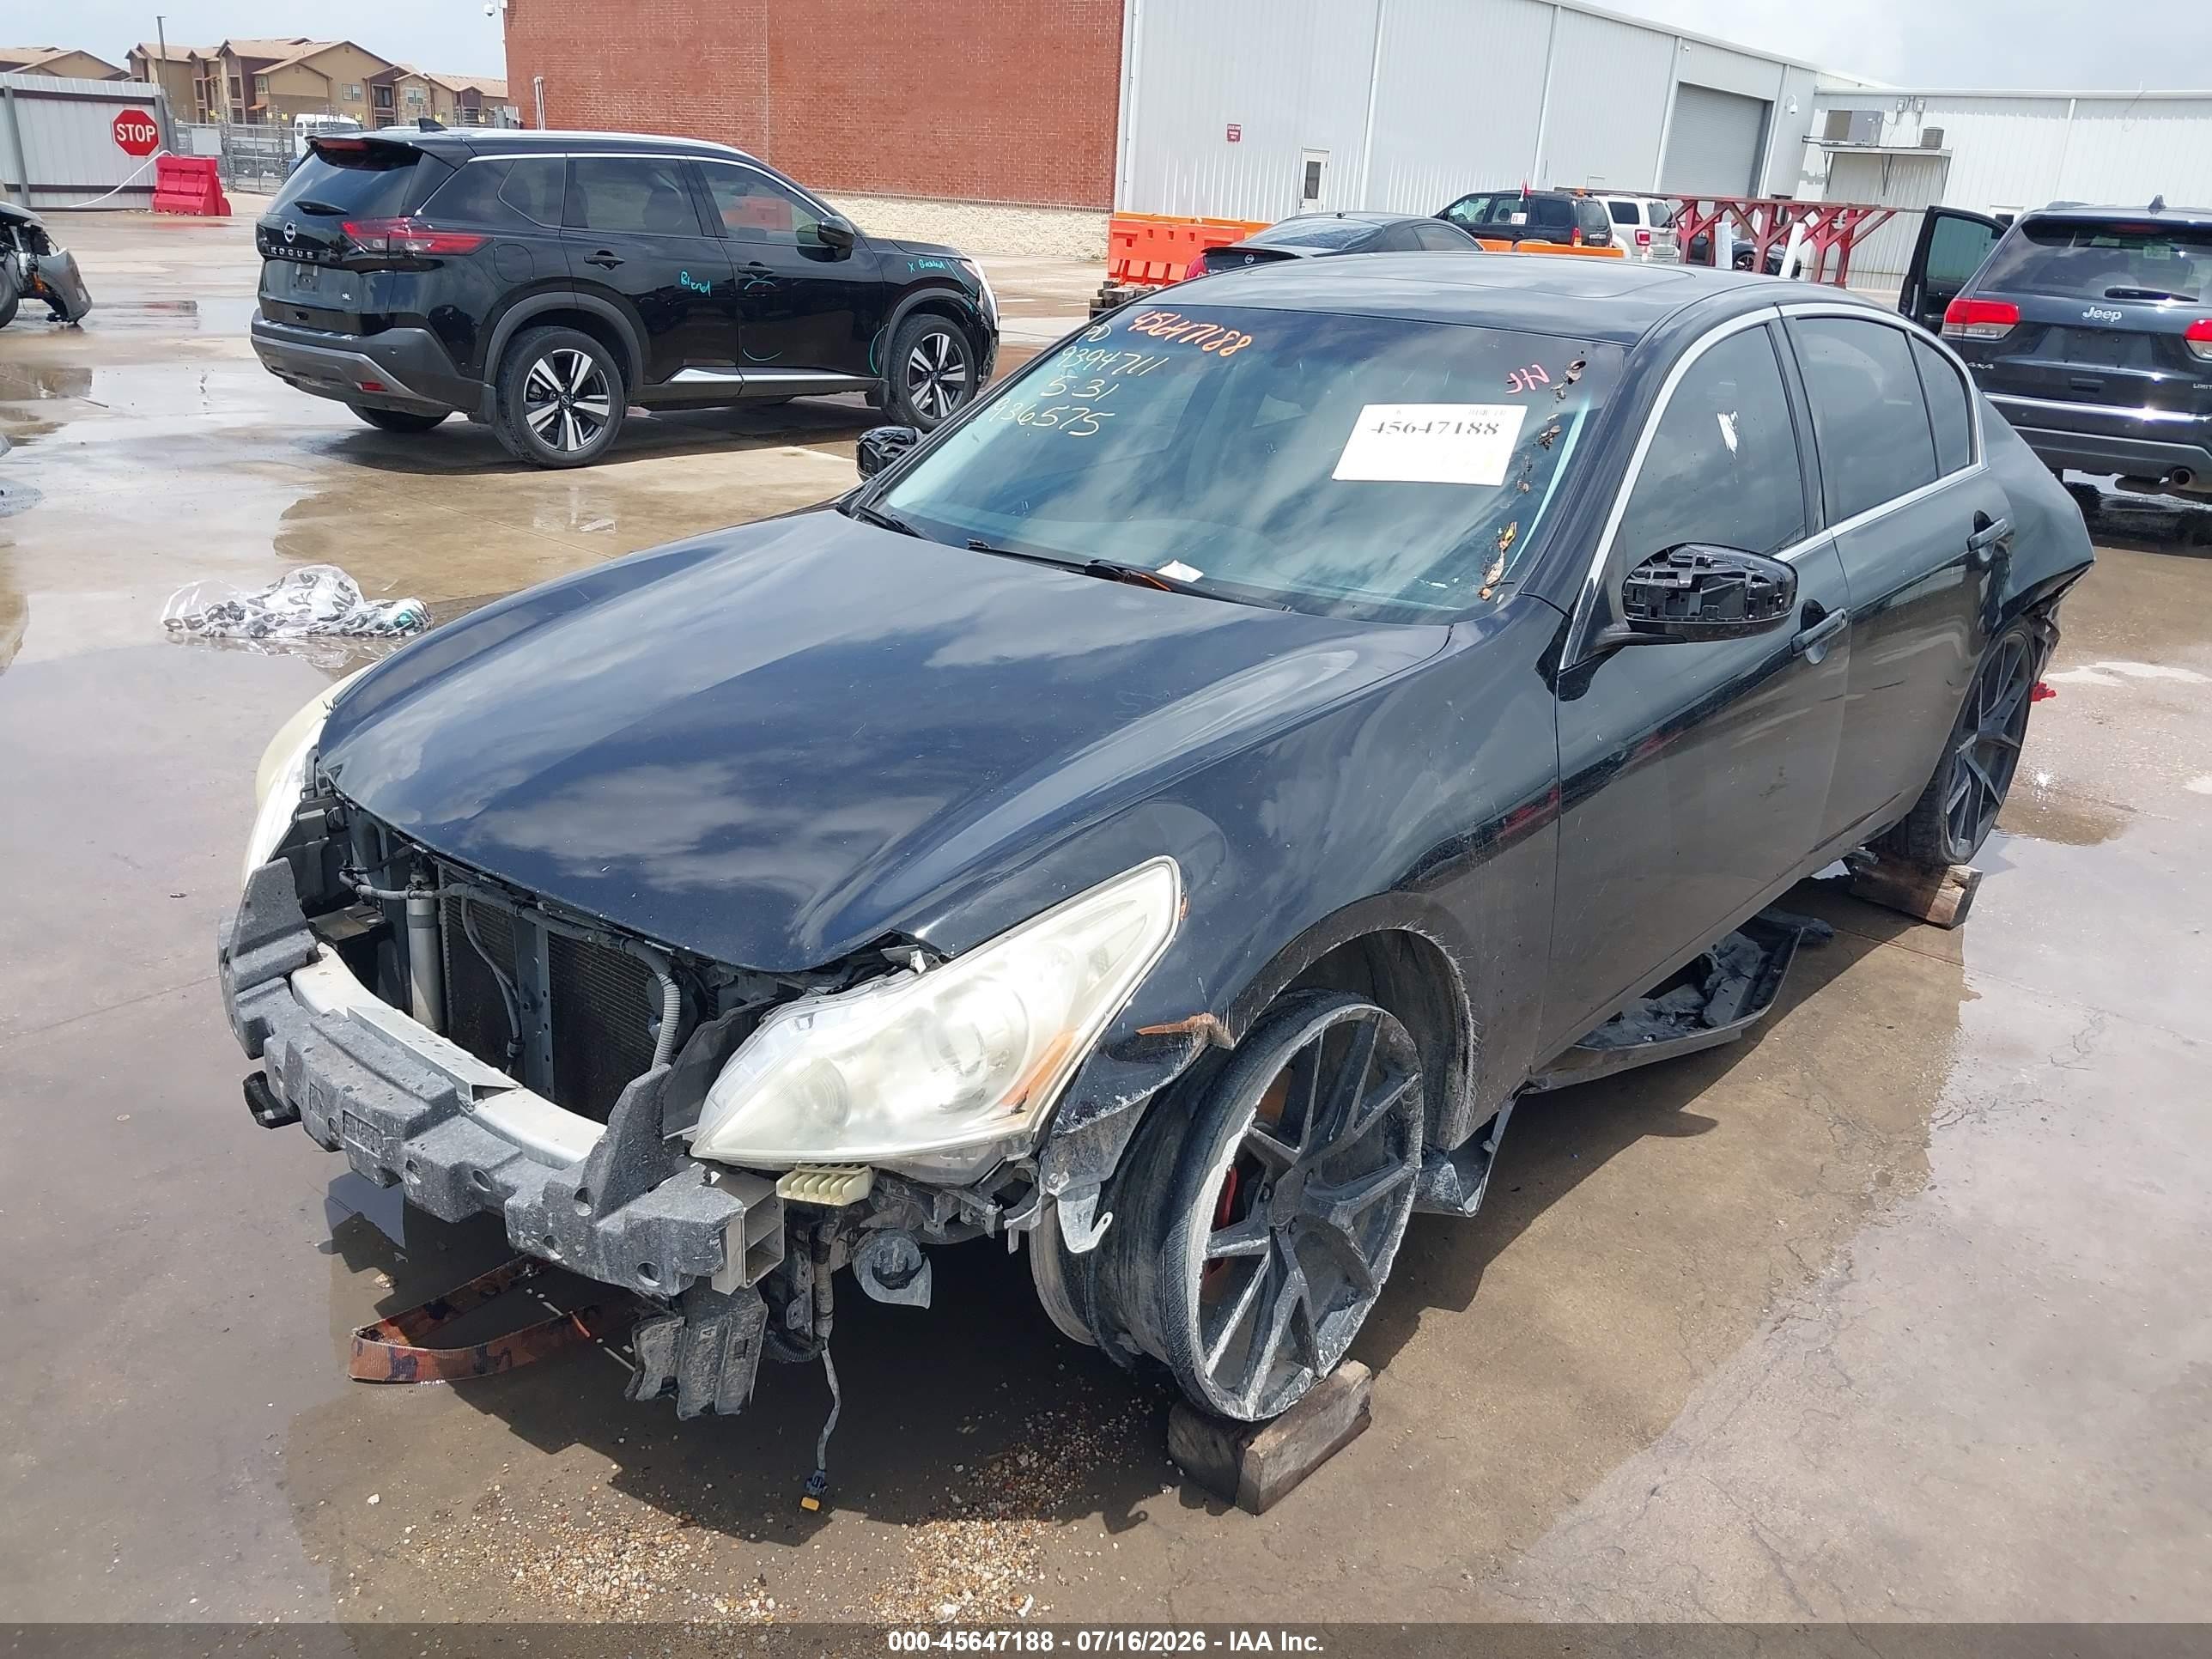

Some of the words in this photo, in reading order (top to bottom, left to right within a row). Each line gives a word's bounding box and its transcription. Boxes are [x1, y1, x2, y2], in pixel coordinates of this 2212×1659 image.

[116, 124, 155, 143] STOP
[270, 246, 314, 259] ROGUE
[2081, 306, 2123, 322] Jeep
[1127, 310, 1253, 357] 45647188
[1056, 345, 1170, 377] 9394711
[988, 398, 1115, 436] 936575
[1370, 420, 1500, 436] 45647188
